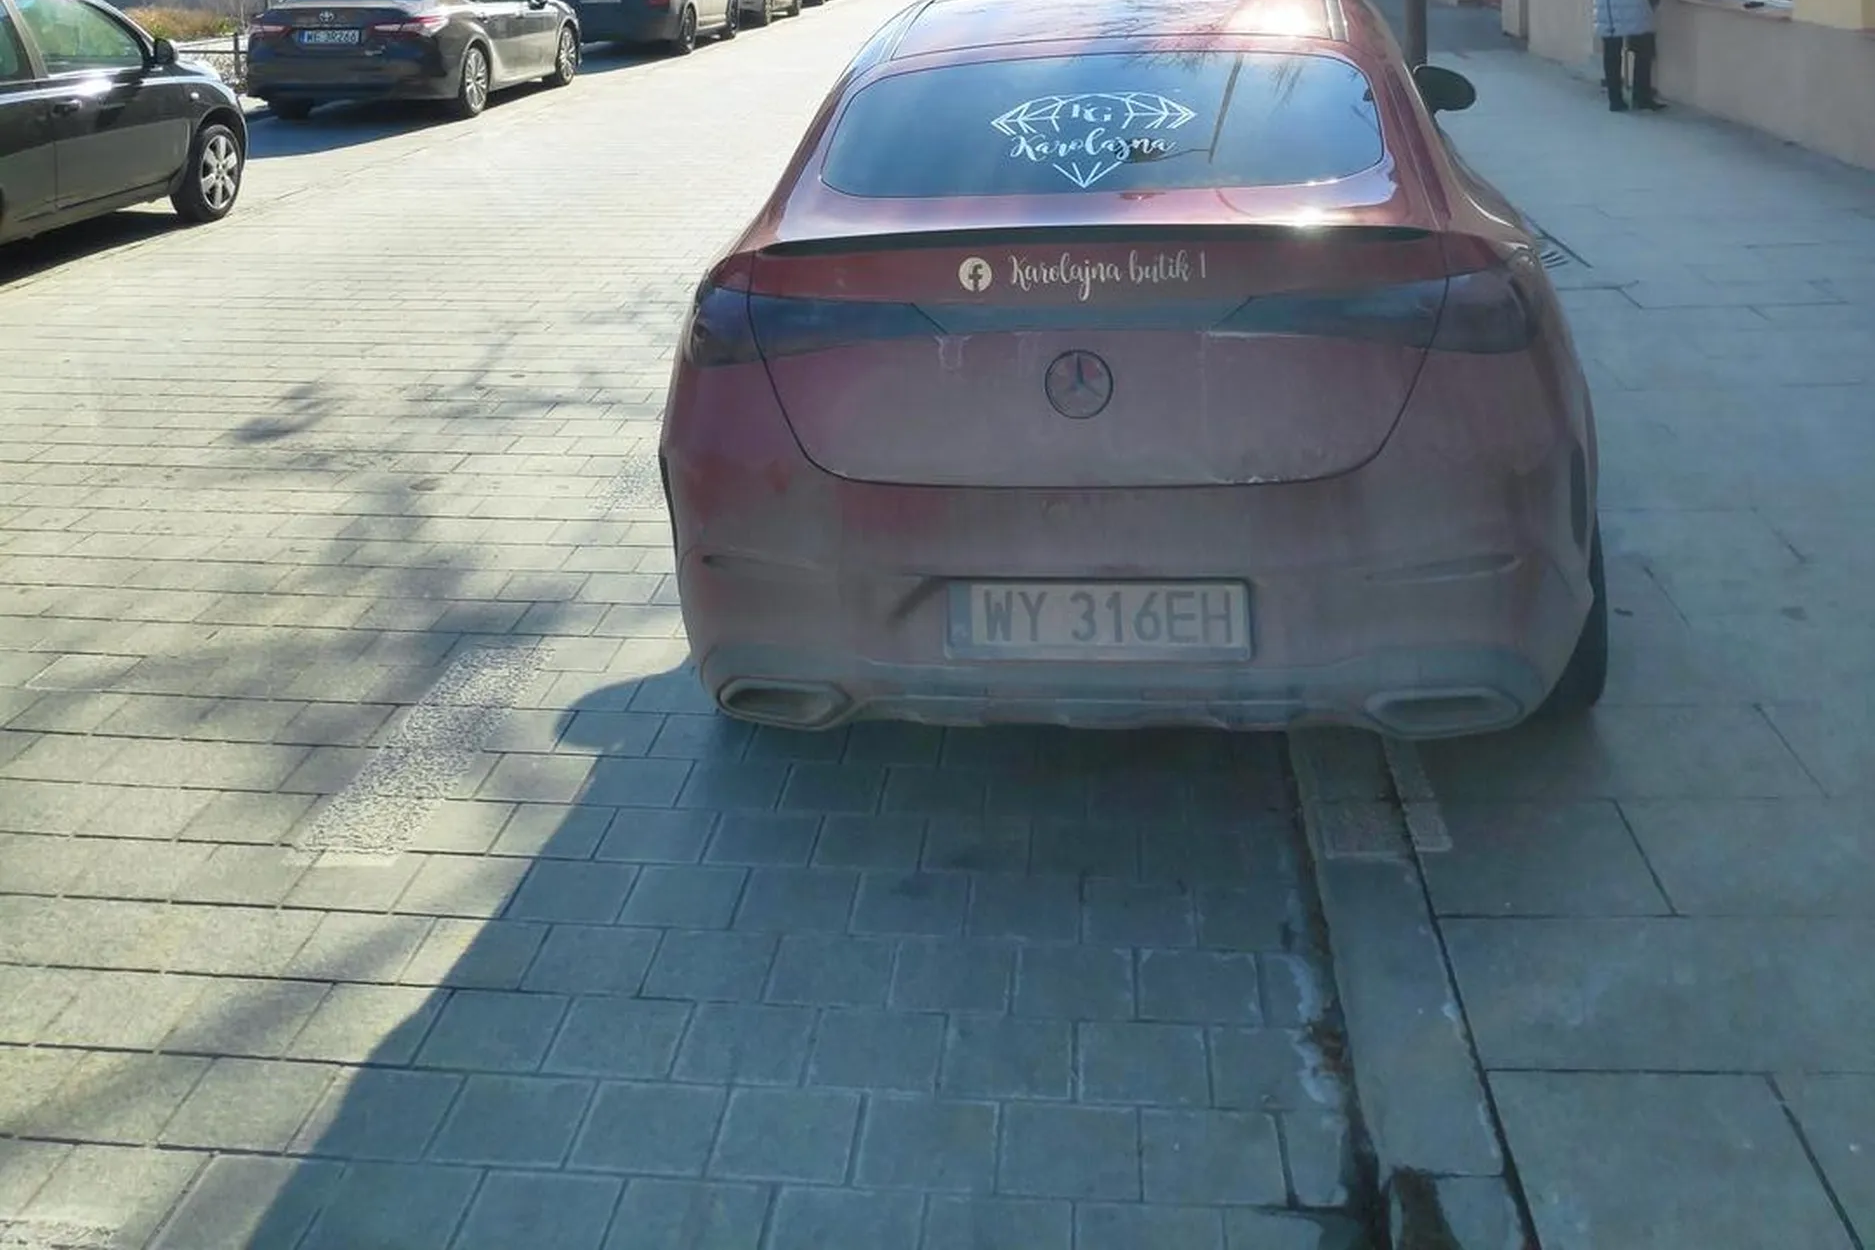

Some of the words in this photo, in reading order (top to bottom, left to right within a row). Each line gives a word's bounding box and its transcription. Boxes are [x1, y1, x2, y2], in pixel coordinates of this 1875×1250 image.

[1010, 252, 1122, 301] Karolajna
[1129, 250, 1192, 283] butik
[983, 590, 1048, 642] WY
[1069, 590, 1233, 644] 316EH
